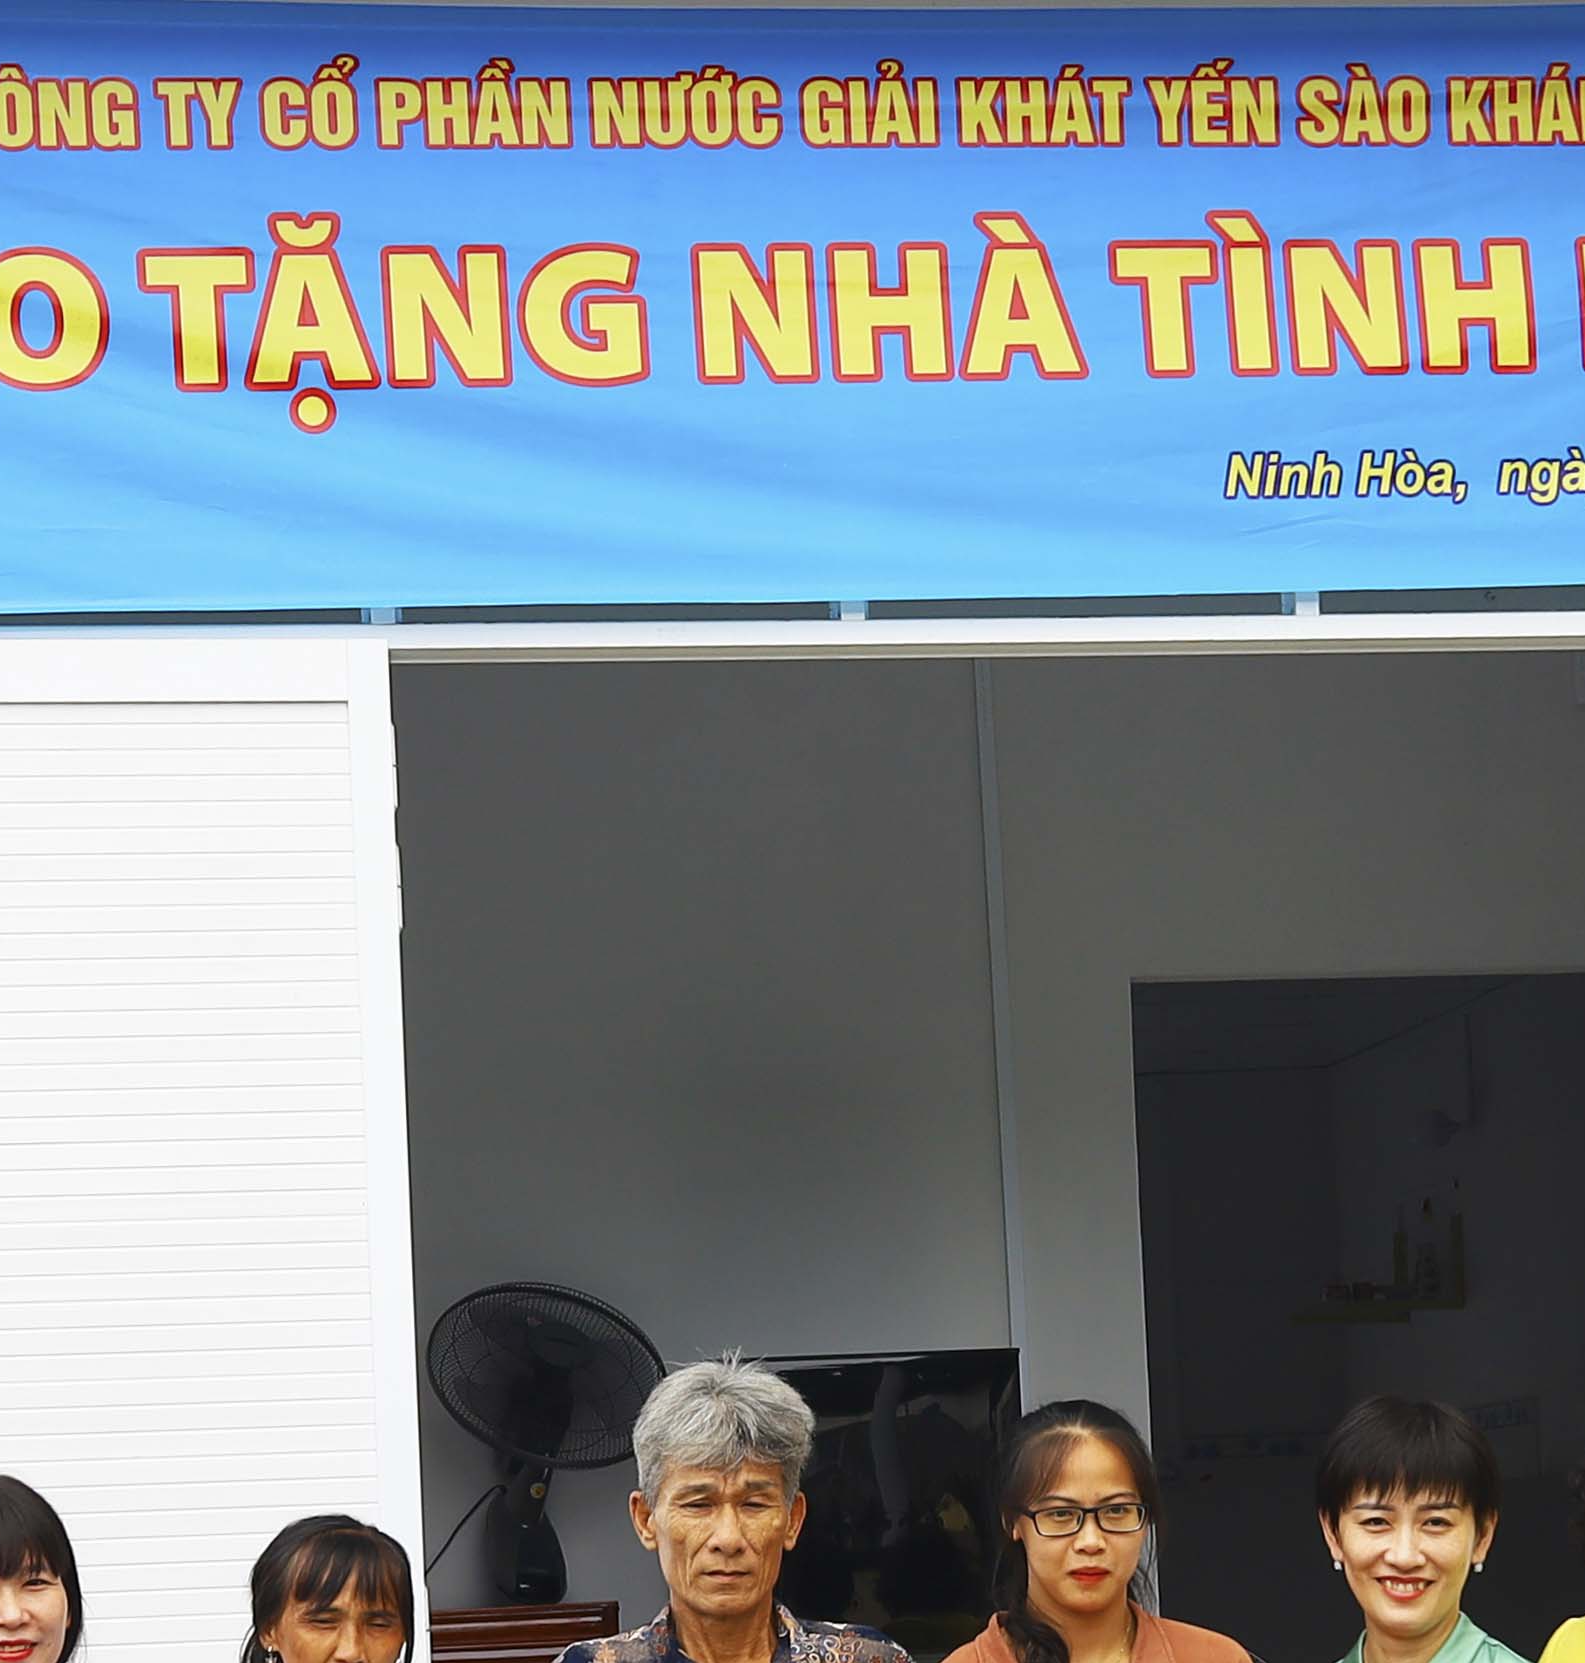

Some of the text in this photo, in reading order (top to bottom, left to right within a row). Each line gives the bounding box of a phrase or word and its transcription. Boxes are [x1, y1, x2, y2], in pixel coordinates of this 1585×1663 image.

[154, 75, 235, 150] TY
[260, 55, 360, 152] CỔ
[378, 56, 564, 152] PHẦN
[591, 62, 775, 152] NƯỚC
[801, 59, 938, 148] GIẢI
[957, 75, 1131, 148] KHÁT
[1147, 58, 1277, 148] YẾN
[1300, 62, 1431, 148] SÀO
[138, 212, 648, 435] TẶNG
[693, 210, 1088, 385] NHÀ
[1111, 210, 1535, 378] TÌNH
[1225, 448, 1341, 502] Ninh
[1356, 448, 1468, 505] Hòa,
